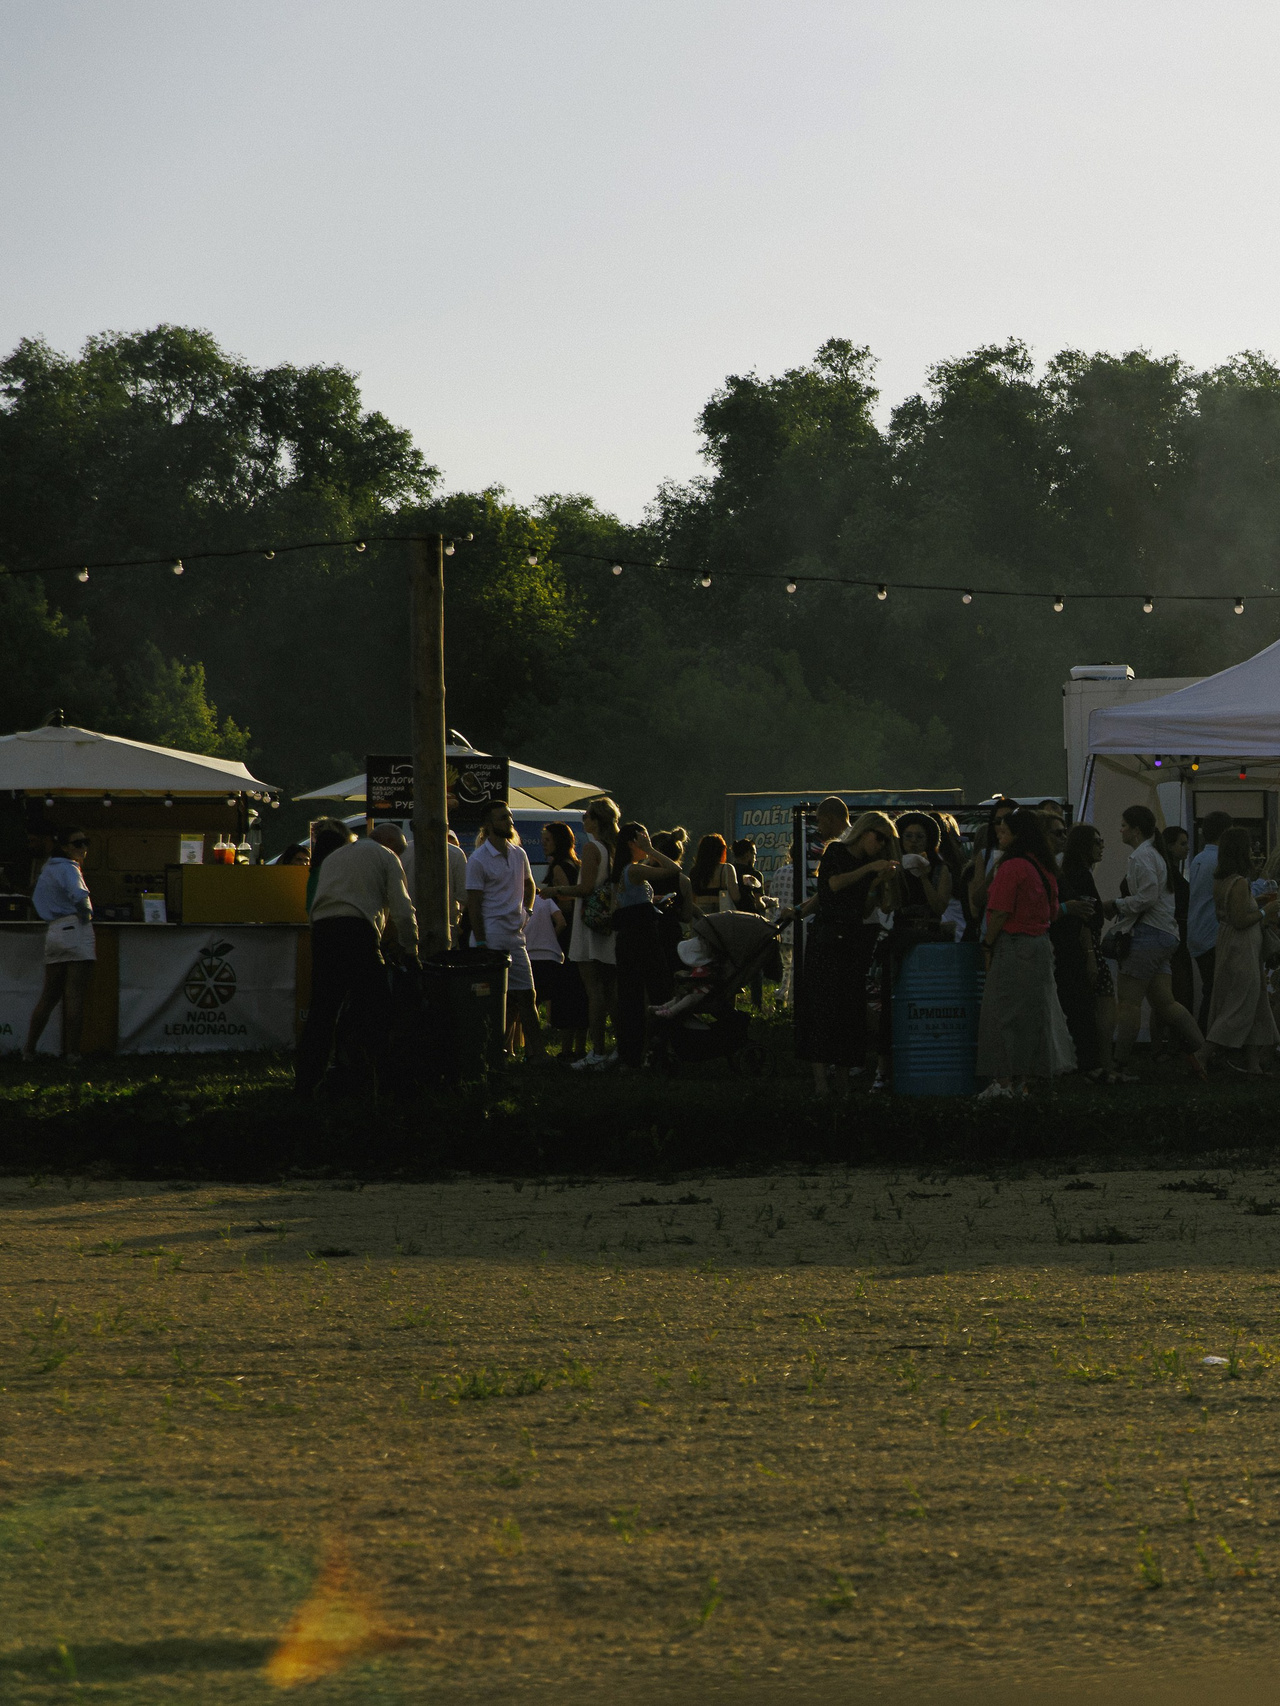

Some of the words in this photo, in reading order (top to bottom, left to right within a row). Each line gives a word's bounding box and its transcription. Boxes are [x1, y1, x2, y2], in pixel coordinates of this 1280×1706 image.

[373, 776, 390, 784] ХОТ
[391, 776, 415, 785] ДОГИ
[483, 781, 503, 791] РУБ
[187, 1011, 227, 1023] NADA
[164, 1023, 248, 1036] LEMONADA
